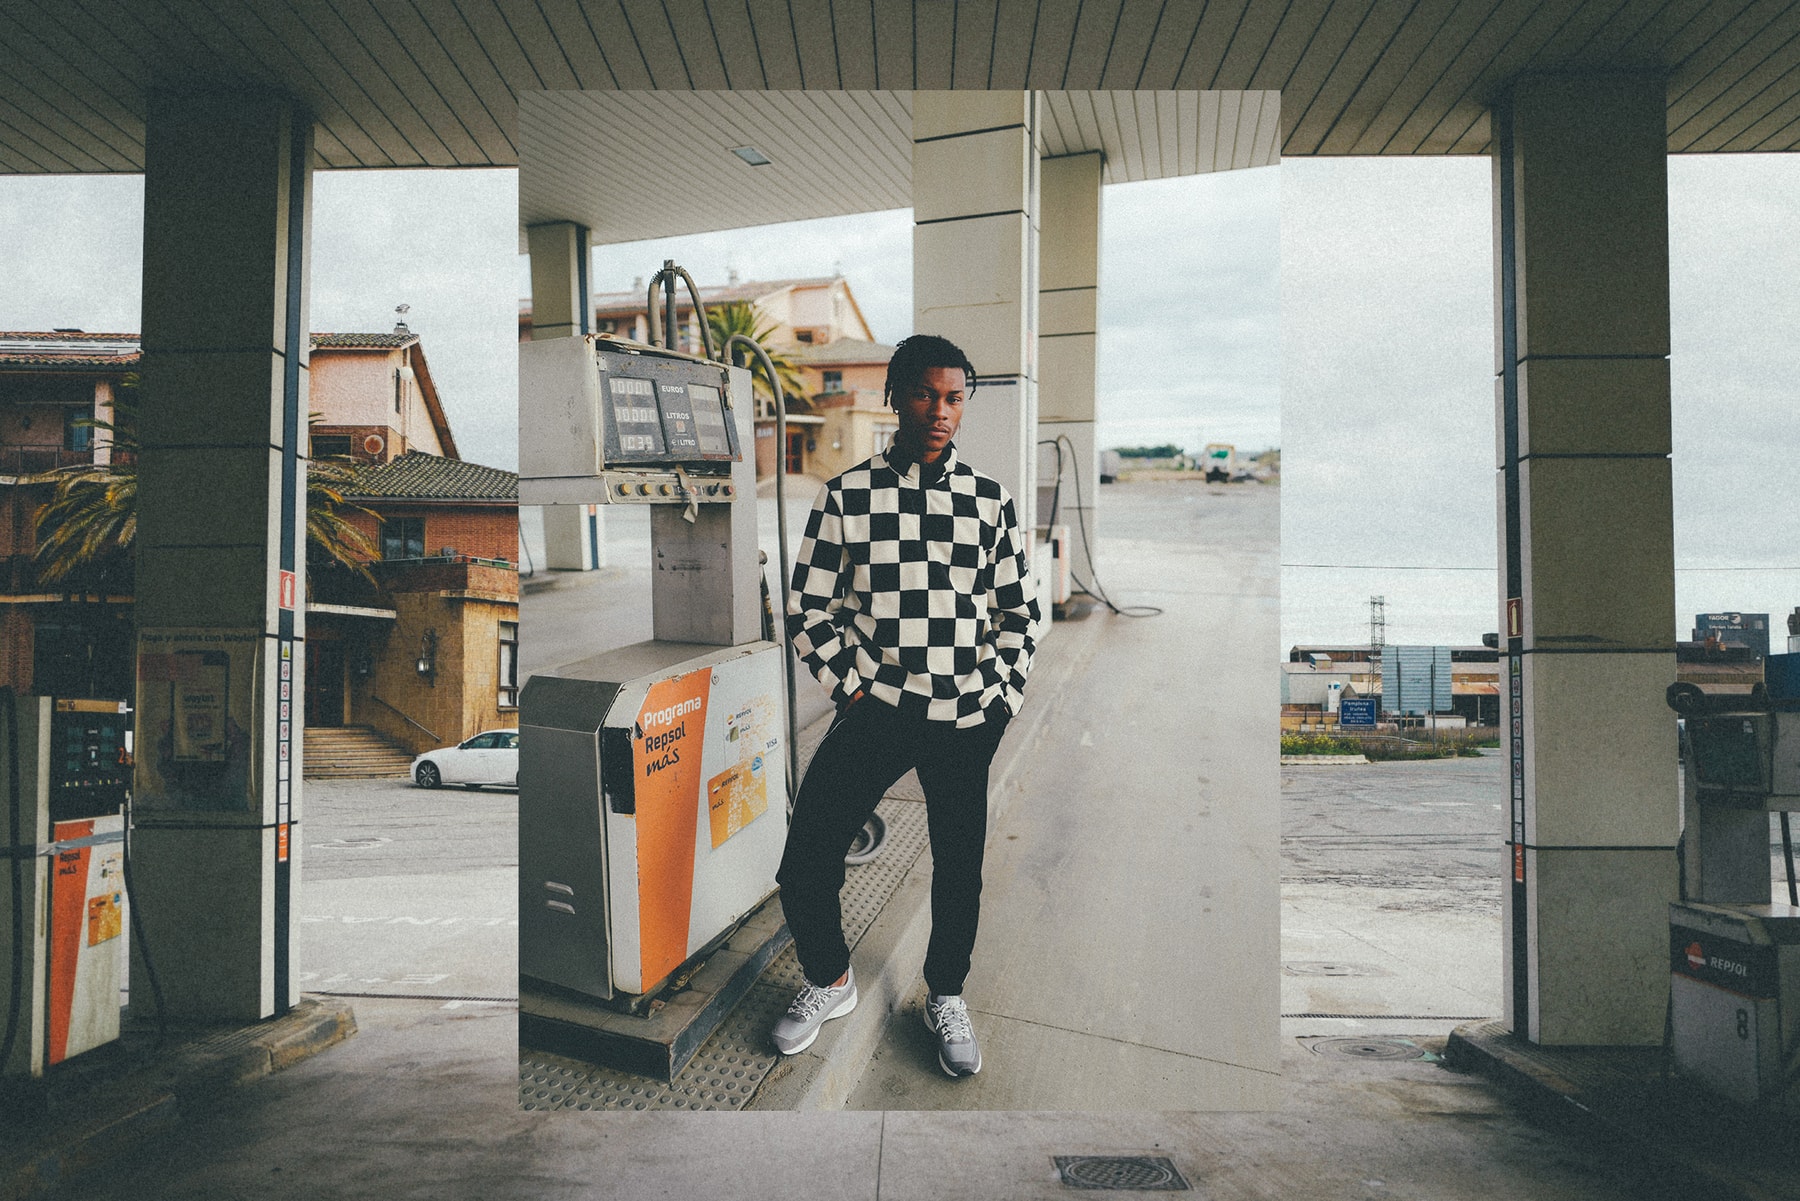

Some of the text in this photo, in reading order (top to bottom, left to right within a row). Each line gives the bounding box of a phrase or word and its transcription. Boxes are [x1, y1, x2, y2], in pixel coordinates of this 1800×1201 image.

[661, 385, 684, 394] EUROS
[666, 412, 690, 421] LITROS
[643, 696, 702, 730] Programa
[645, 721, 687, 754] Repsol
[766, 738, 778, 750] VISA
[646, 745, 681, 777] más
[1710, 956, 1748, 977] REPSOL
[1736, 1008, 1749, 1041] 8
